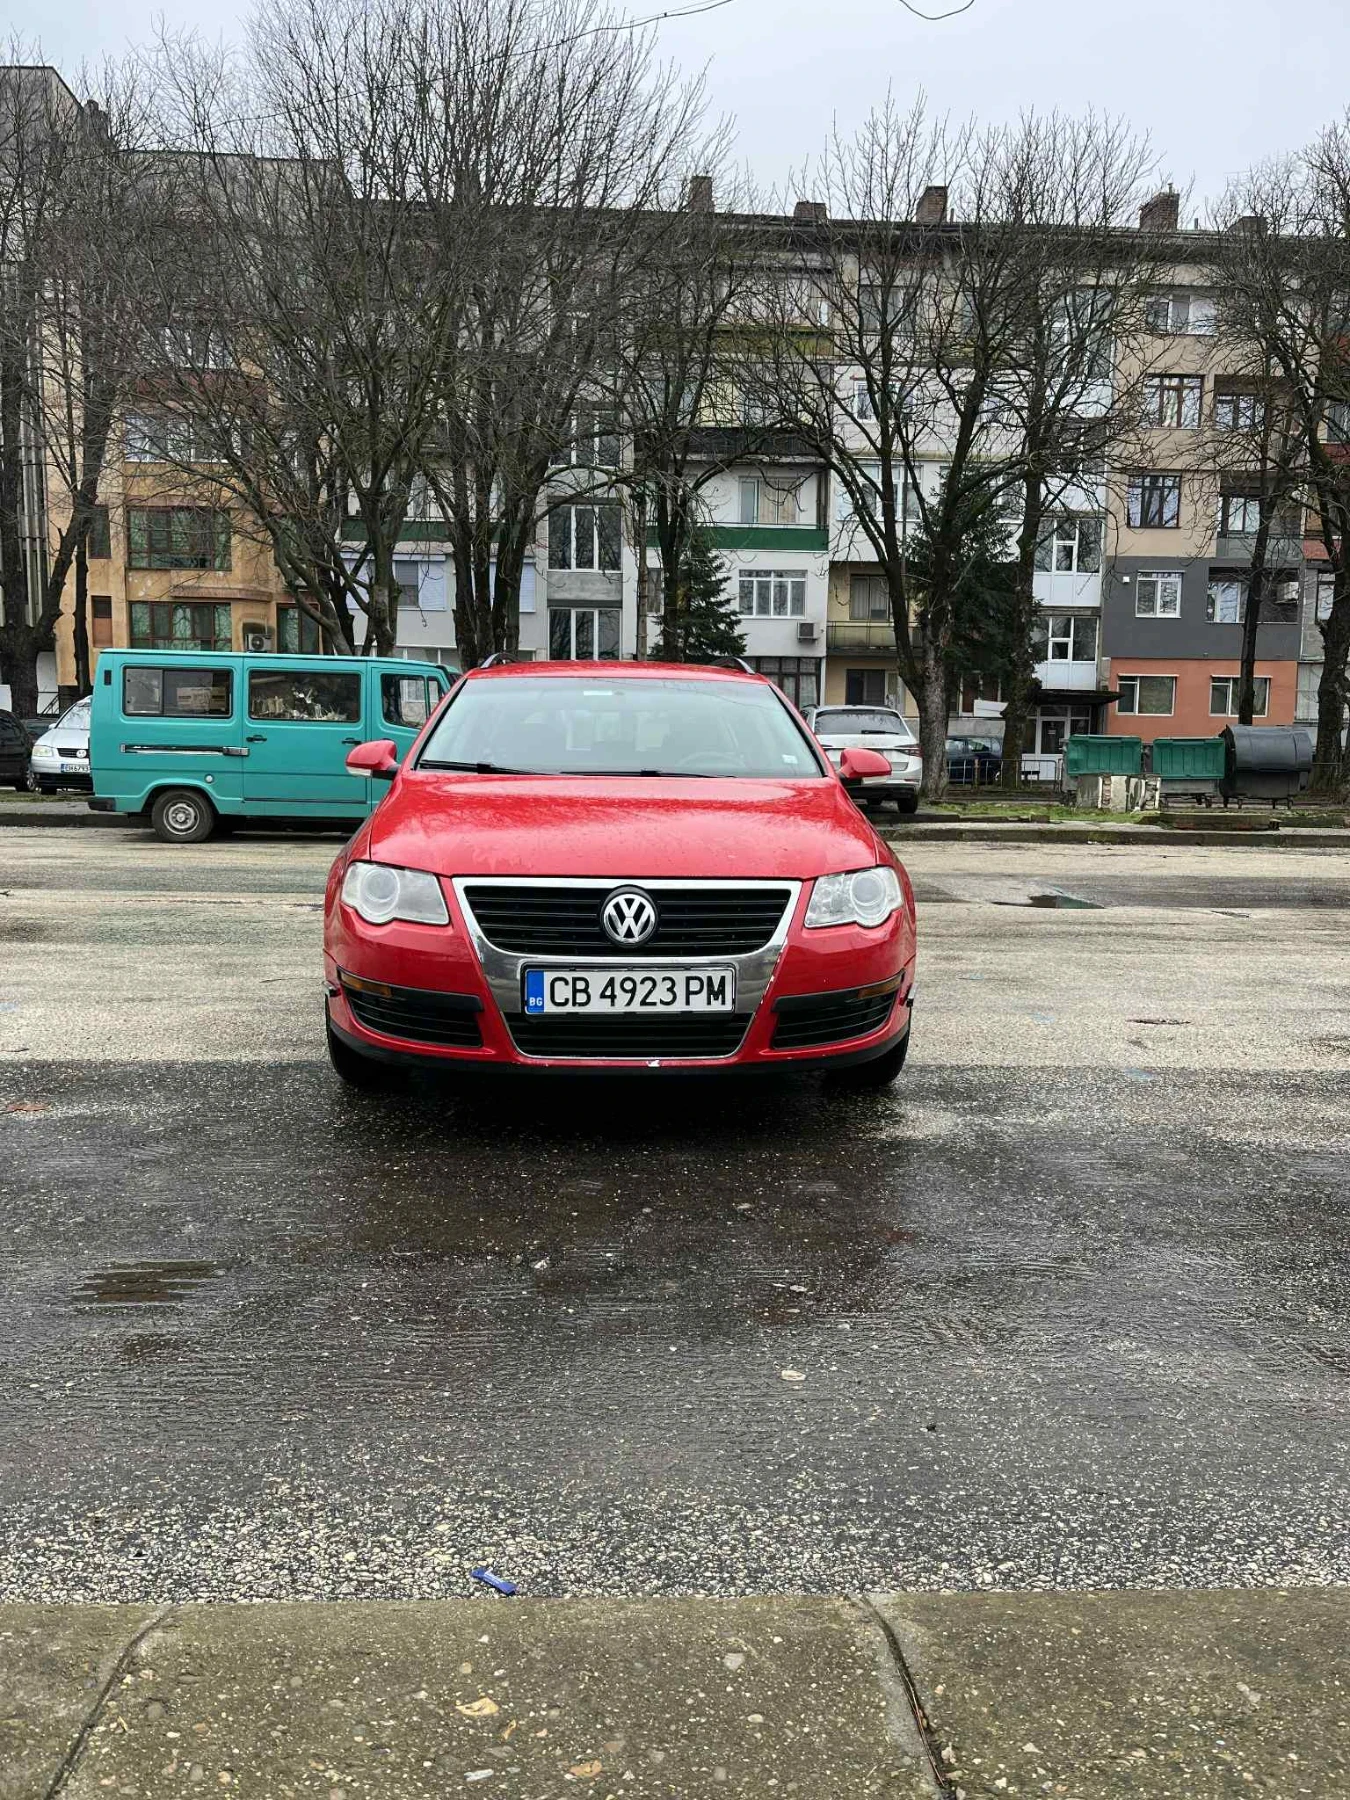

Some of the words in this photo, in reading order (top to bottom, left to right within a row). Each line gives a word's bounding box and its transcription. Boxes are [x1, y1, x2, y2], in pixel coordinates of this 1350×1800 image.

[603, 893, 656, 944] VW
[529, 997, 543, 1007] BG
[550, 976, 592, 1007] CB
[600, 976, 678, 1007] 4923
[685, 975, 726, 1006] PM
